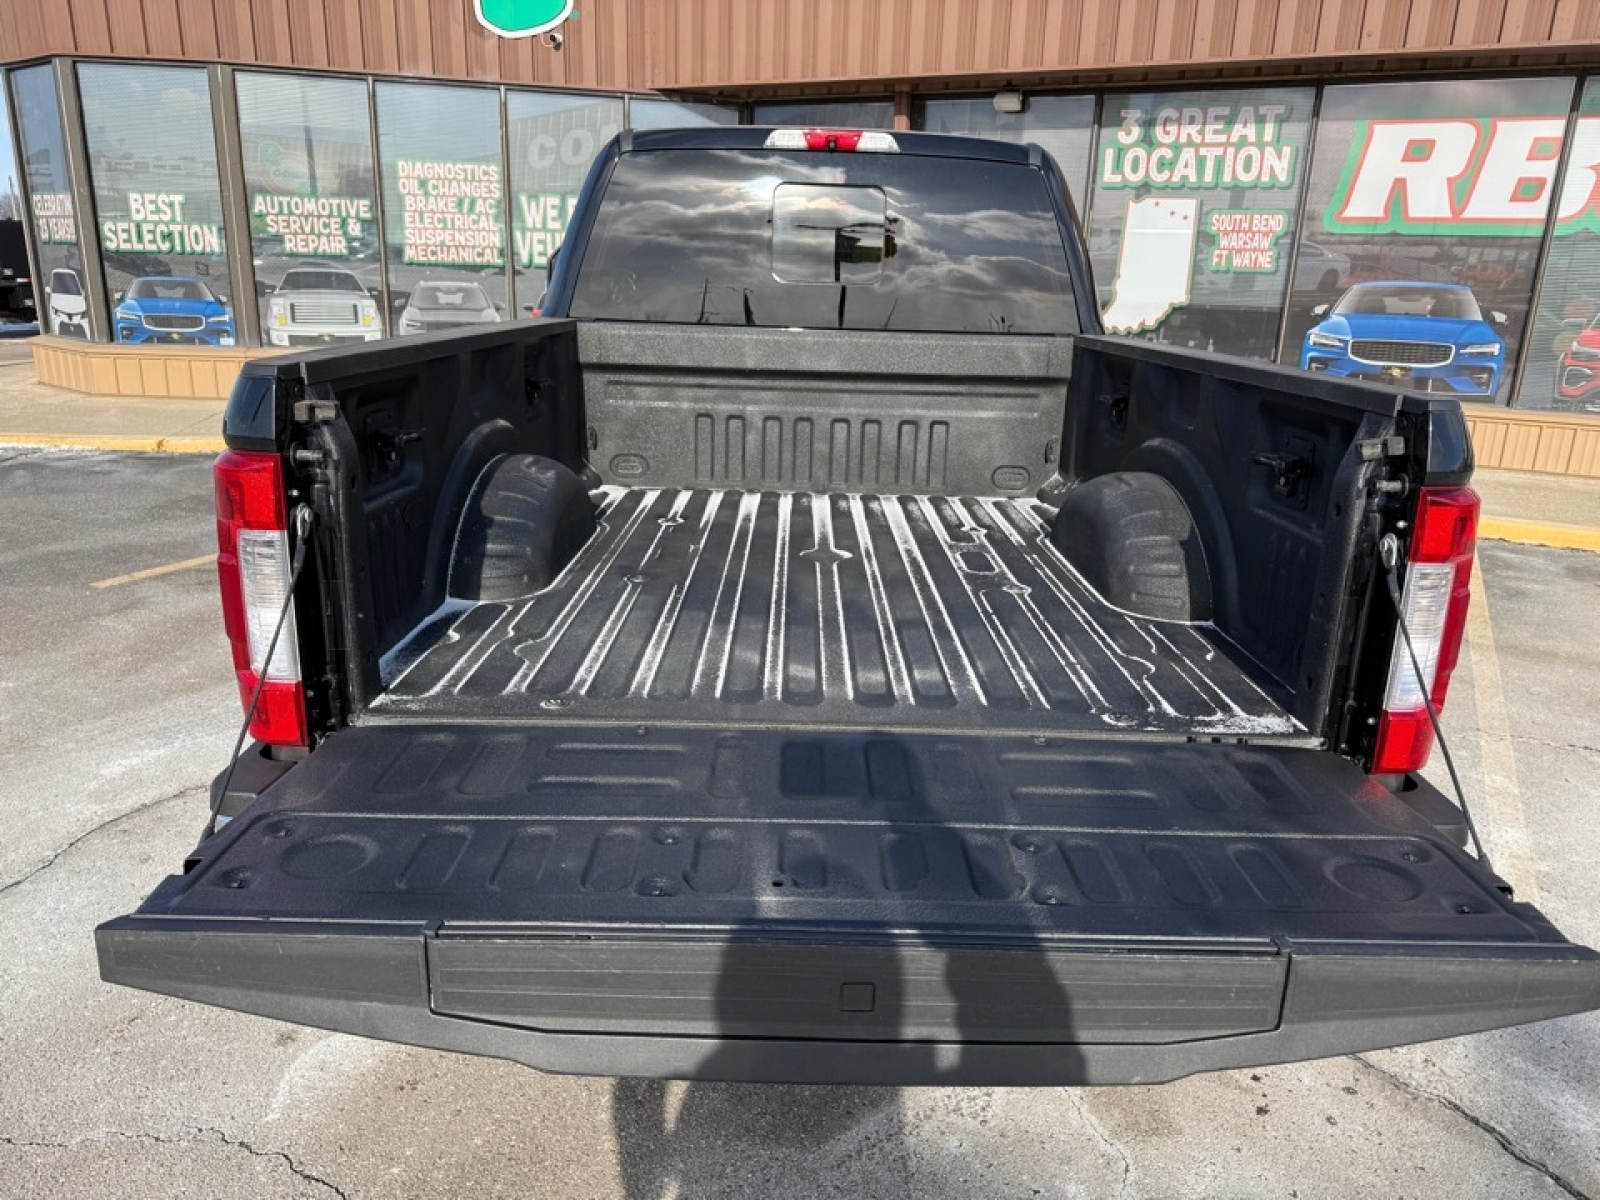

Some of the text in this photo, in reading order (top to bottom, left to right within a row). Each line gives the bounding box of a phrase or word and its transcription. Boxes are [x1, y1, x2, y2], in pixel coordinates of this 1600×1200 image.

[1117, 104, 1287, 144] 3 GREAT
[397, 161, 499, 181] DIAGNOSTICS
[1102, 145, 1293, 184] LOCATION
[398, 178, 501, 198] OIL CHANGES
[129, 192, 184, 222] BEST
[253, 195, 371, 218] AUTOMOTIVE
[404, 195, 458, 212] BRAKE
[474, 198, 497, 214] AC
[519, 193, 561, 229] WE
[266, 214, 362, 236] SERVICE &
[405, 212, 498, 230] ELECTRICAL
[1211, 213, 1285, 231] SOUTH BEND
[103, 221, 220, 253] SELECTION
[283, 234, 348, 254] REPAIR
[405, 229, 500, 247] SUSPENSION
[1219, 231, 1272, 250] WARSAW
[404, 246, 503, 263] MECHANICAL
[1211, 249, 1276, 269] FT WAYNE
